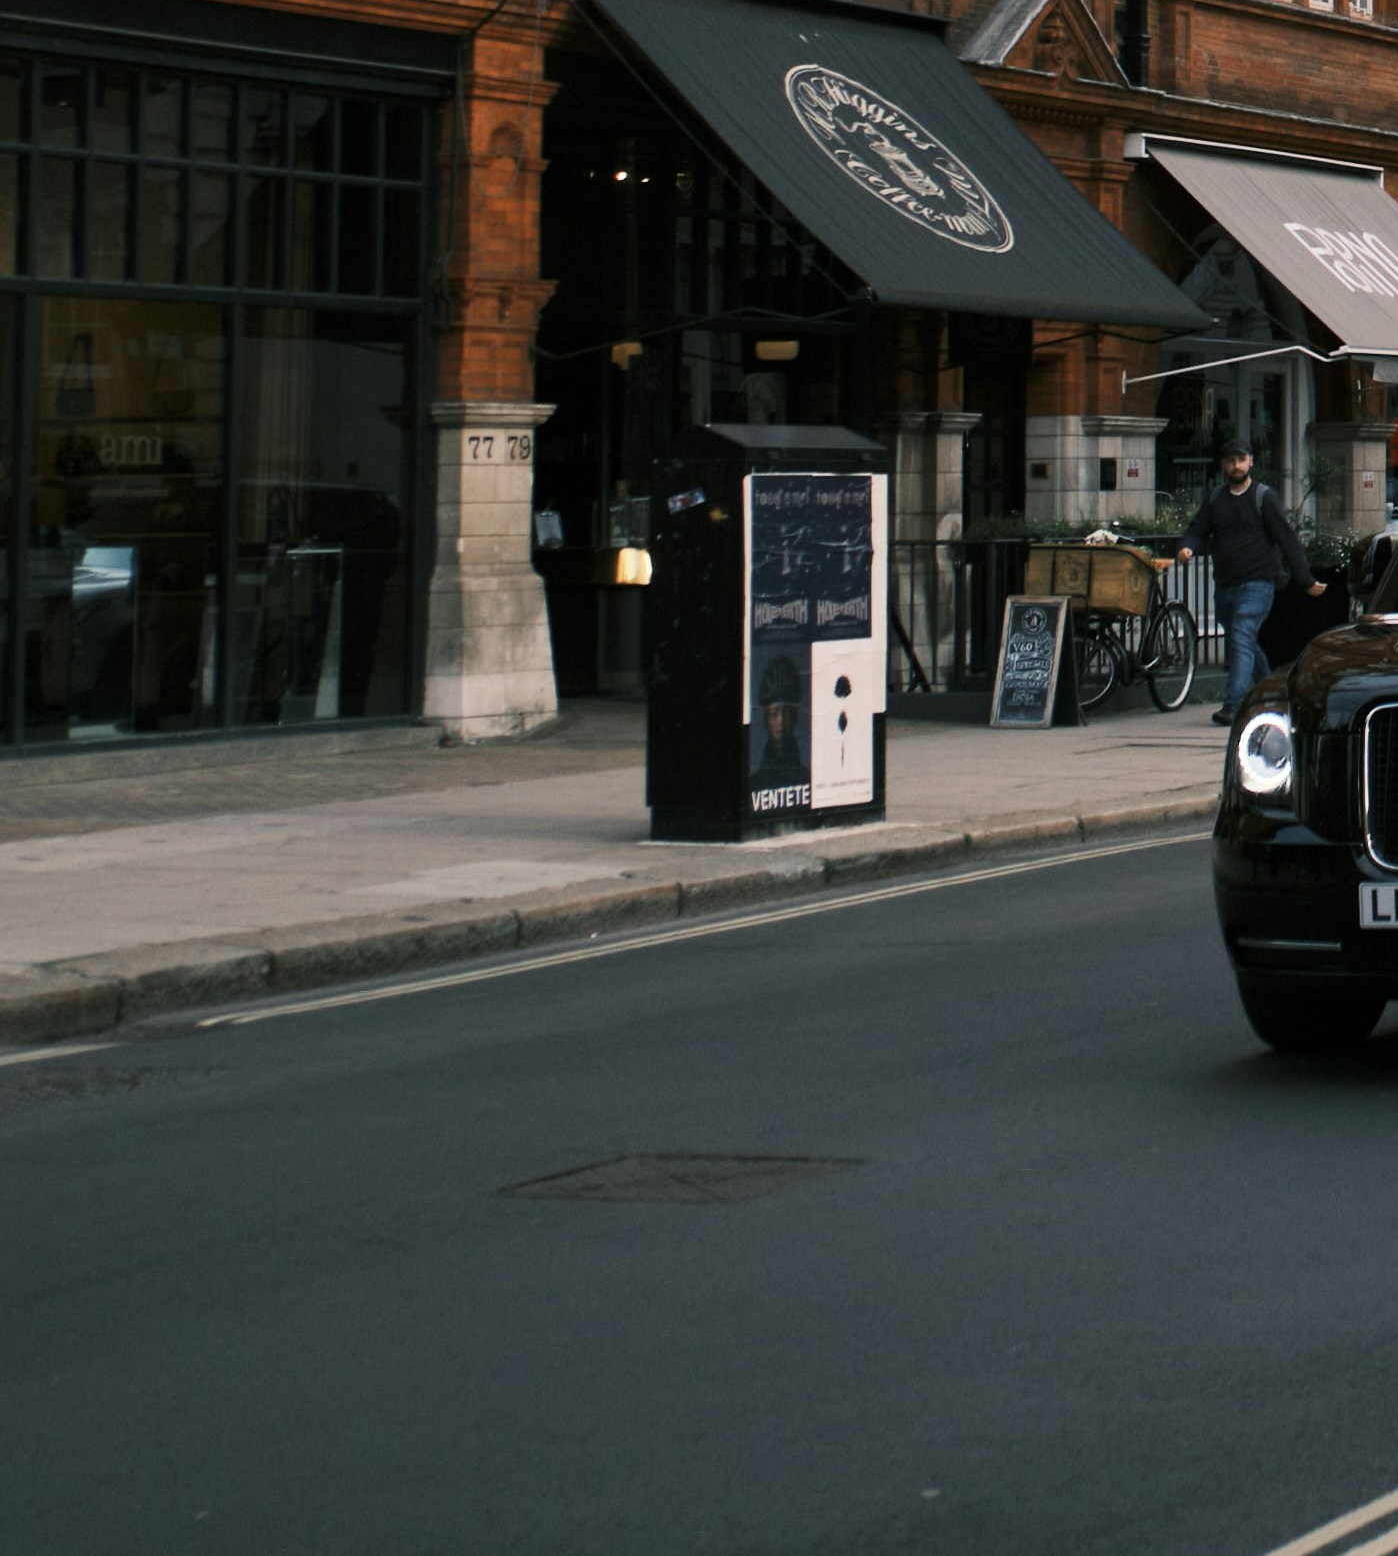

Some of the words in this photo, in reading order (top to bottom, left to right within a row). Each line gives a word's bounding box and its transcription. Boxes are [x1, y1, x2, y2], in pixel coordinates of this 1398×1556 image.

[100, 424, 162, 465] ami
[468, 436, 494, 460] 77
[507, 435, 531, 460] 79
[752, 784, 811, 812] VENTETE
